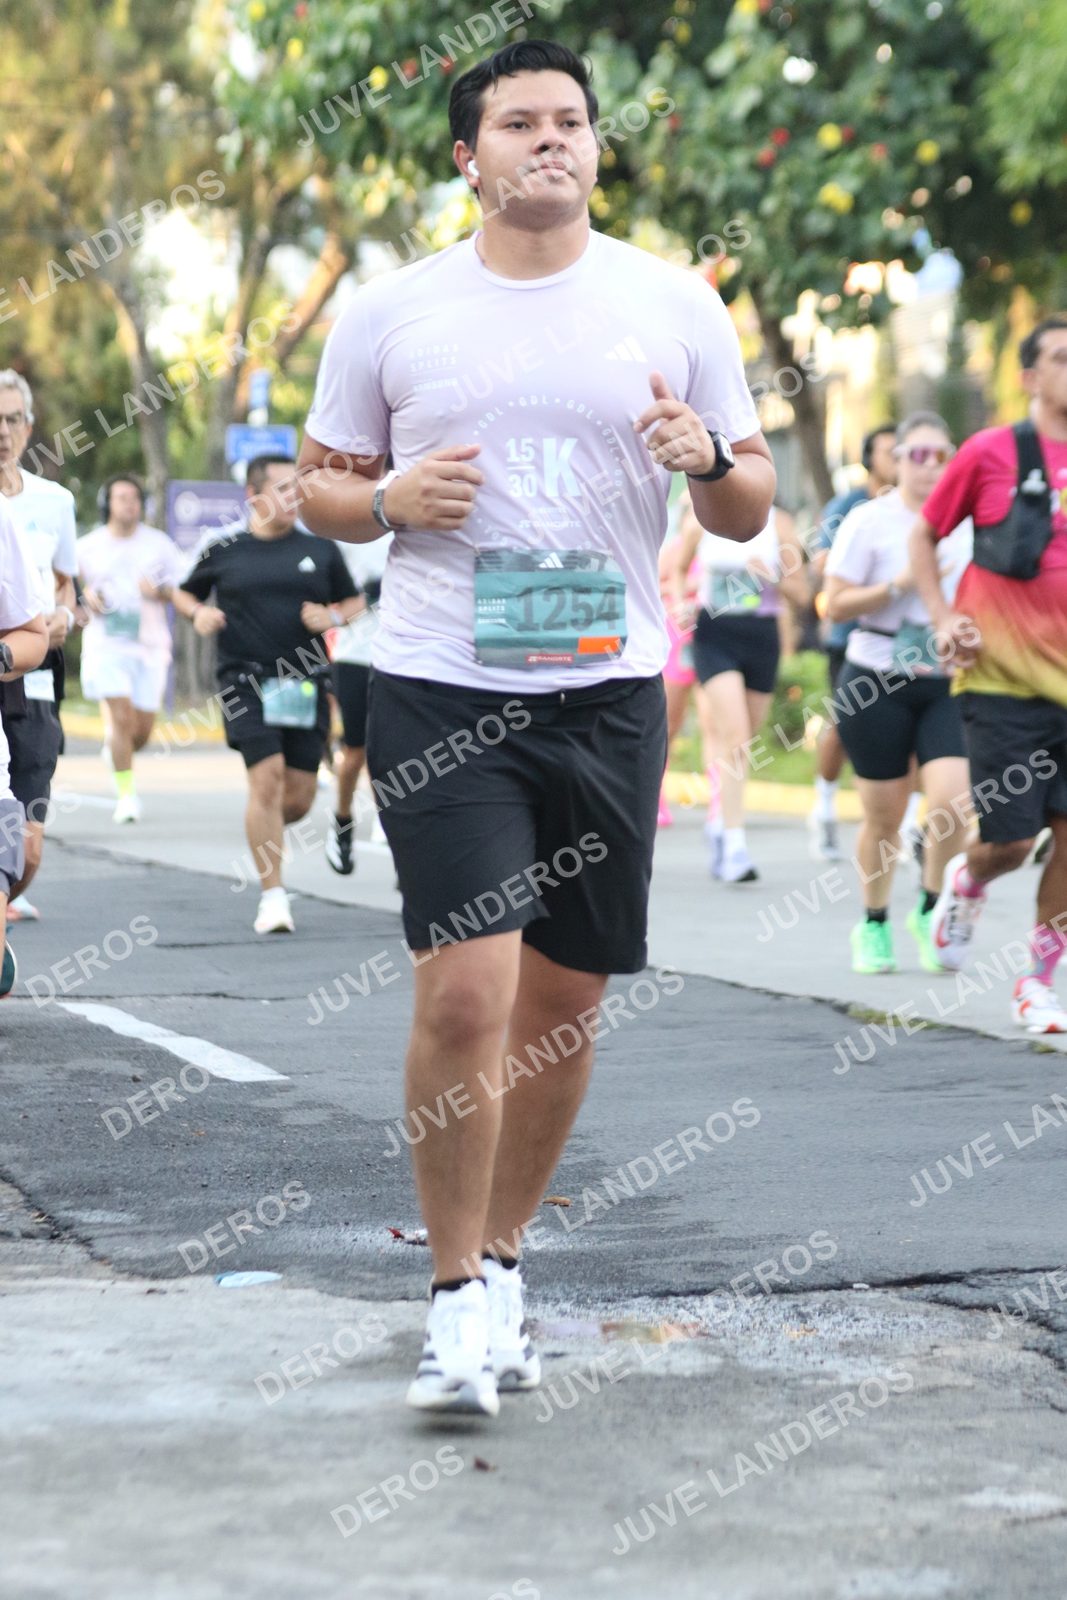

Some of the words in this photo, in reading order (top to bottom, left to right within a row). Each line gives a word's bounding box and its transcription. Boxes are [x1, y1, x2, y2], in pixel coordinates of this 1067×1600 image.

[477, 406, 504, 429] GDL
[518, 395, 548, 407] GDL
[565, 399, 594, 420] GDL
[505, 437, 536, 463] 15
[542, 437, 582, 497] K
[507, 473, 538, 498] 30
[515, 586, 620, 631] 1254
